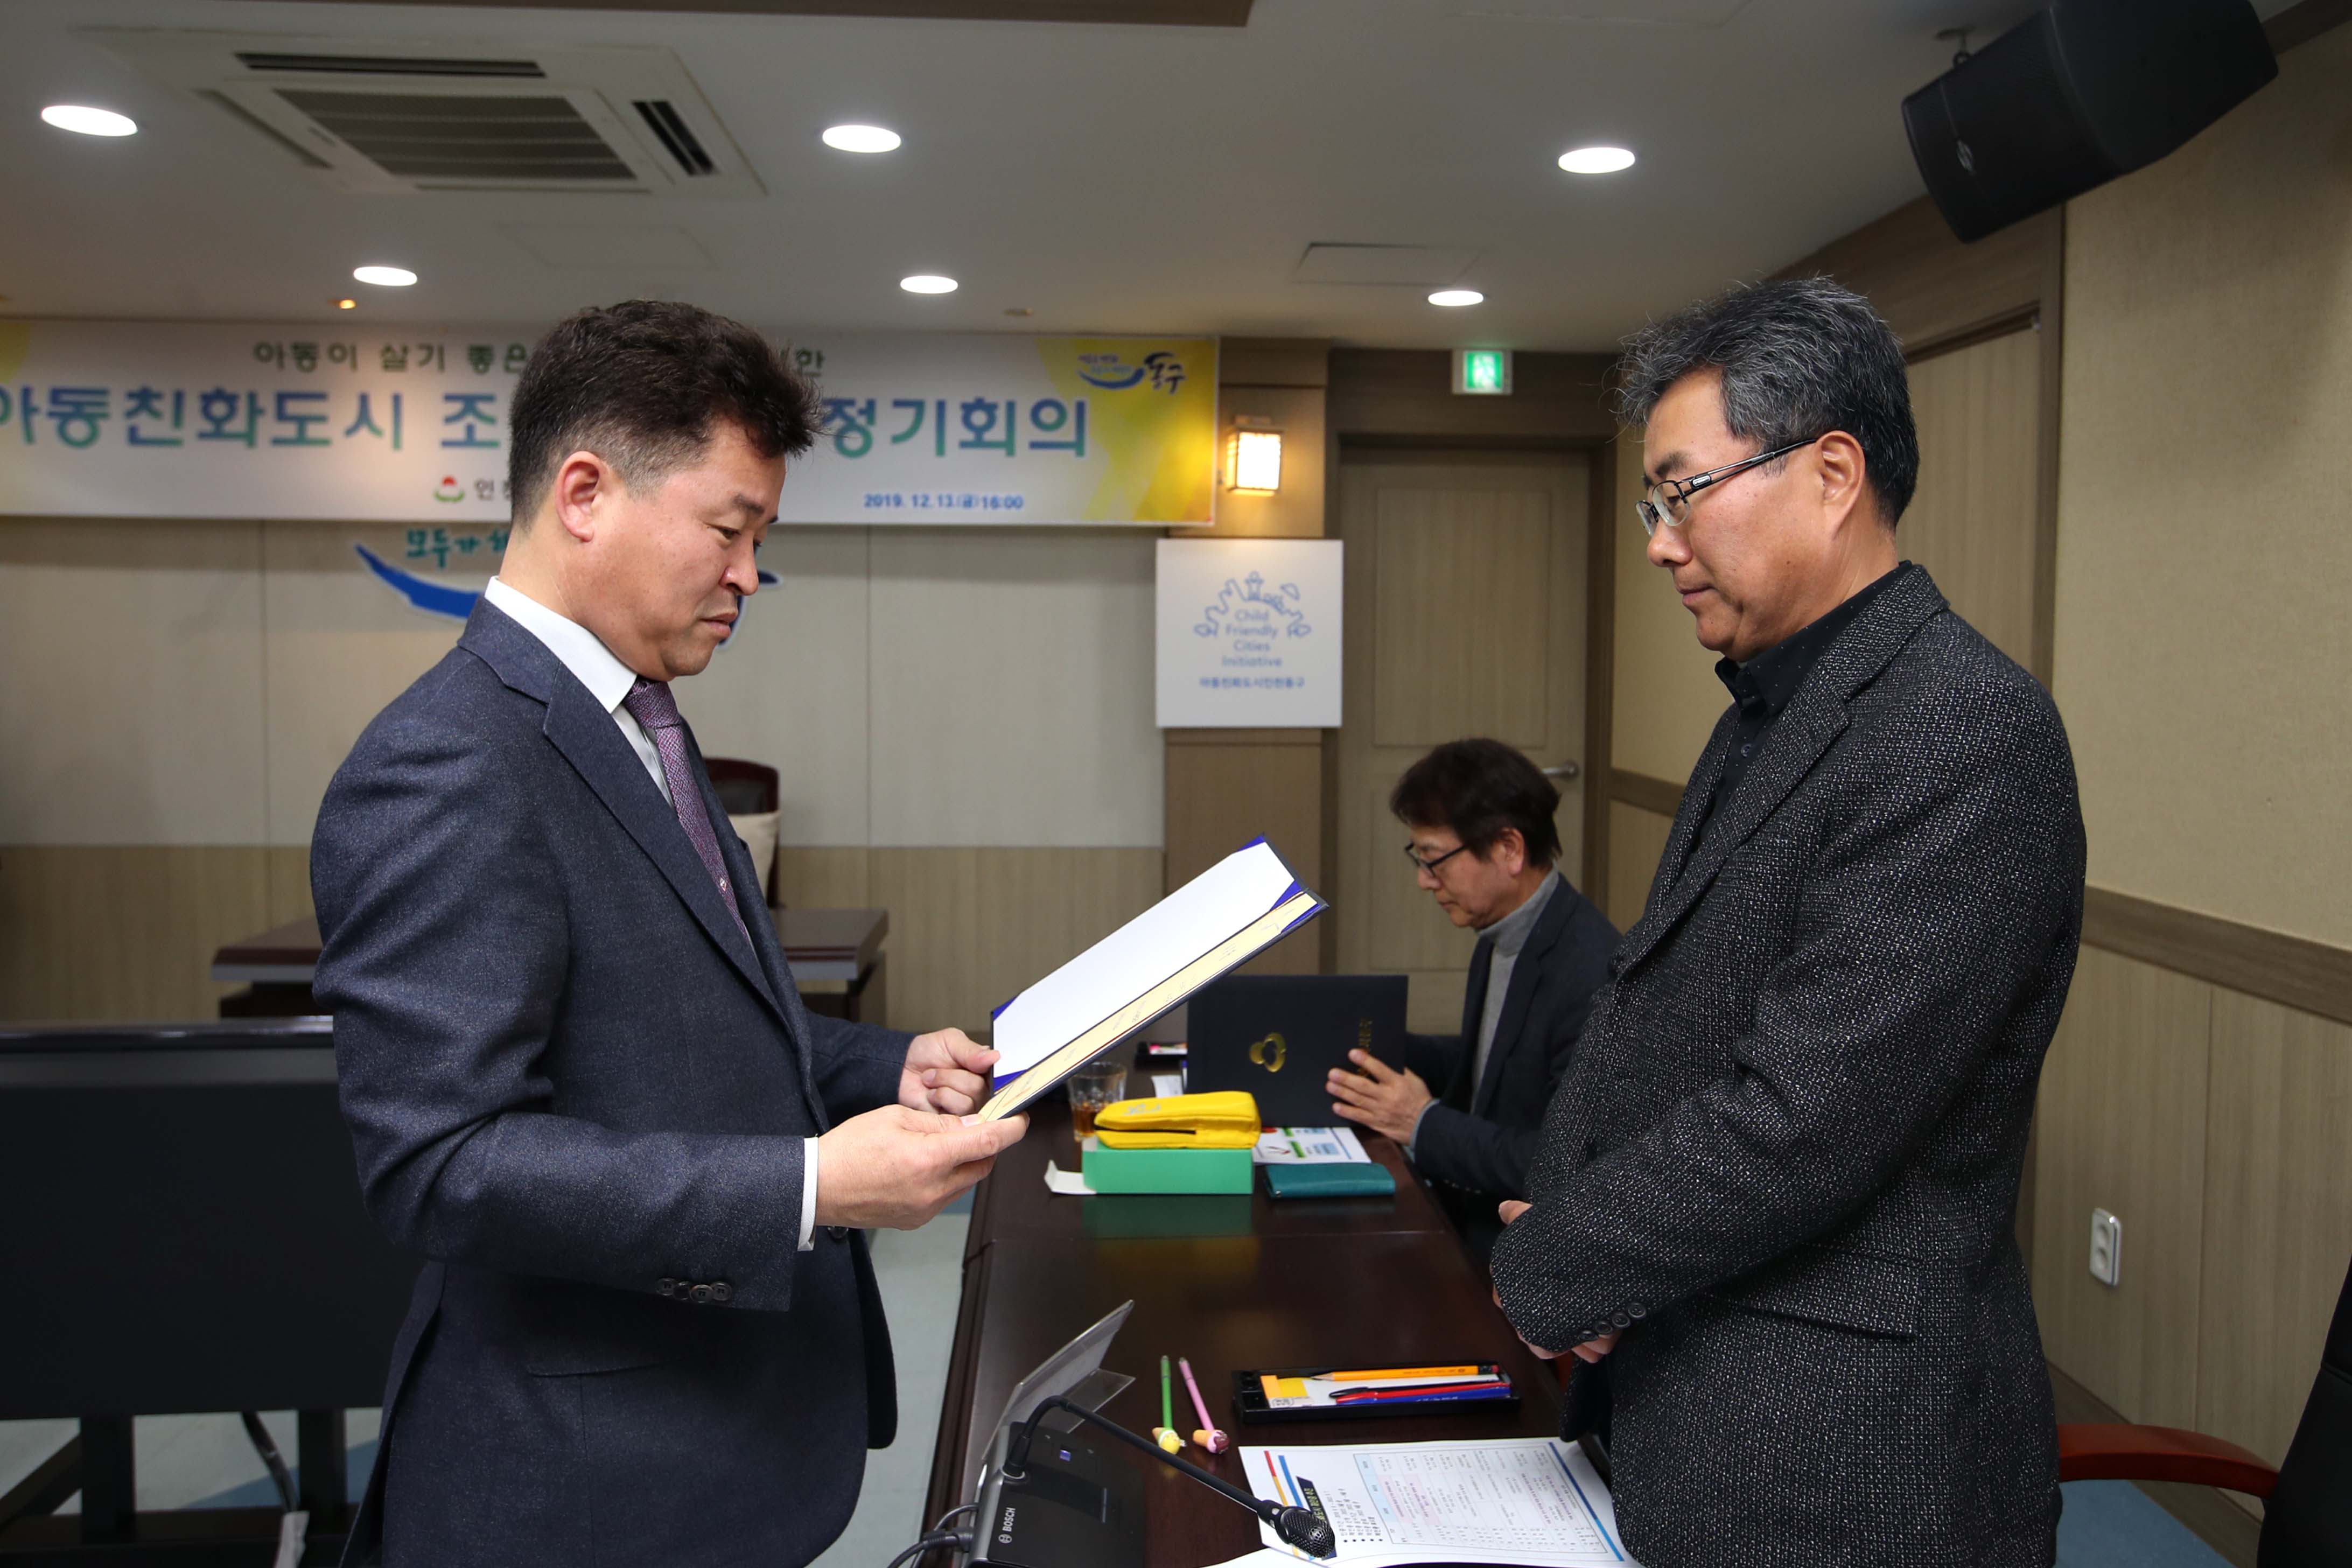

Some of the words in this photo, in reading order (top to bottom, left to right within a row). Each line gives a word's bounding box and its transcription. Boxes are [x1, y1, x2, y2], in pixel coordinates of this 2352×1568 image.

[254, 342, 357, 372] 아동이
[381, 342, 445, 373] 살기
[0, 386, 403, 451] 아동친화도시
[821, 397, 1087, 458] 정기회의
[1235, 609, 1269, 622] Child
[1225, 624, 1278, 639] Friendly
[1233, 640, 1270, 652] Cities
[1222, 656, 1282, 667] Initiative
[1002, 1507, 1016, 1532] BOSCH
